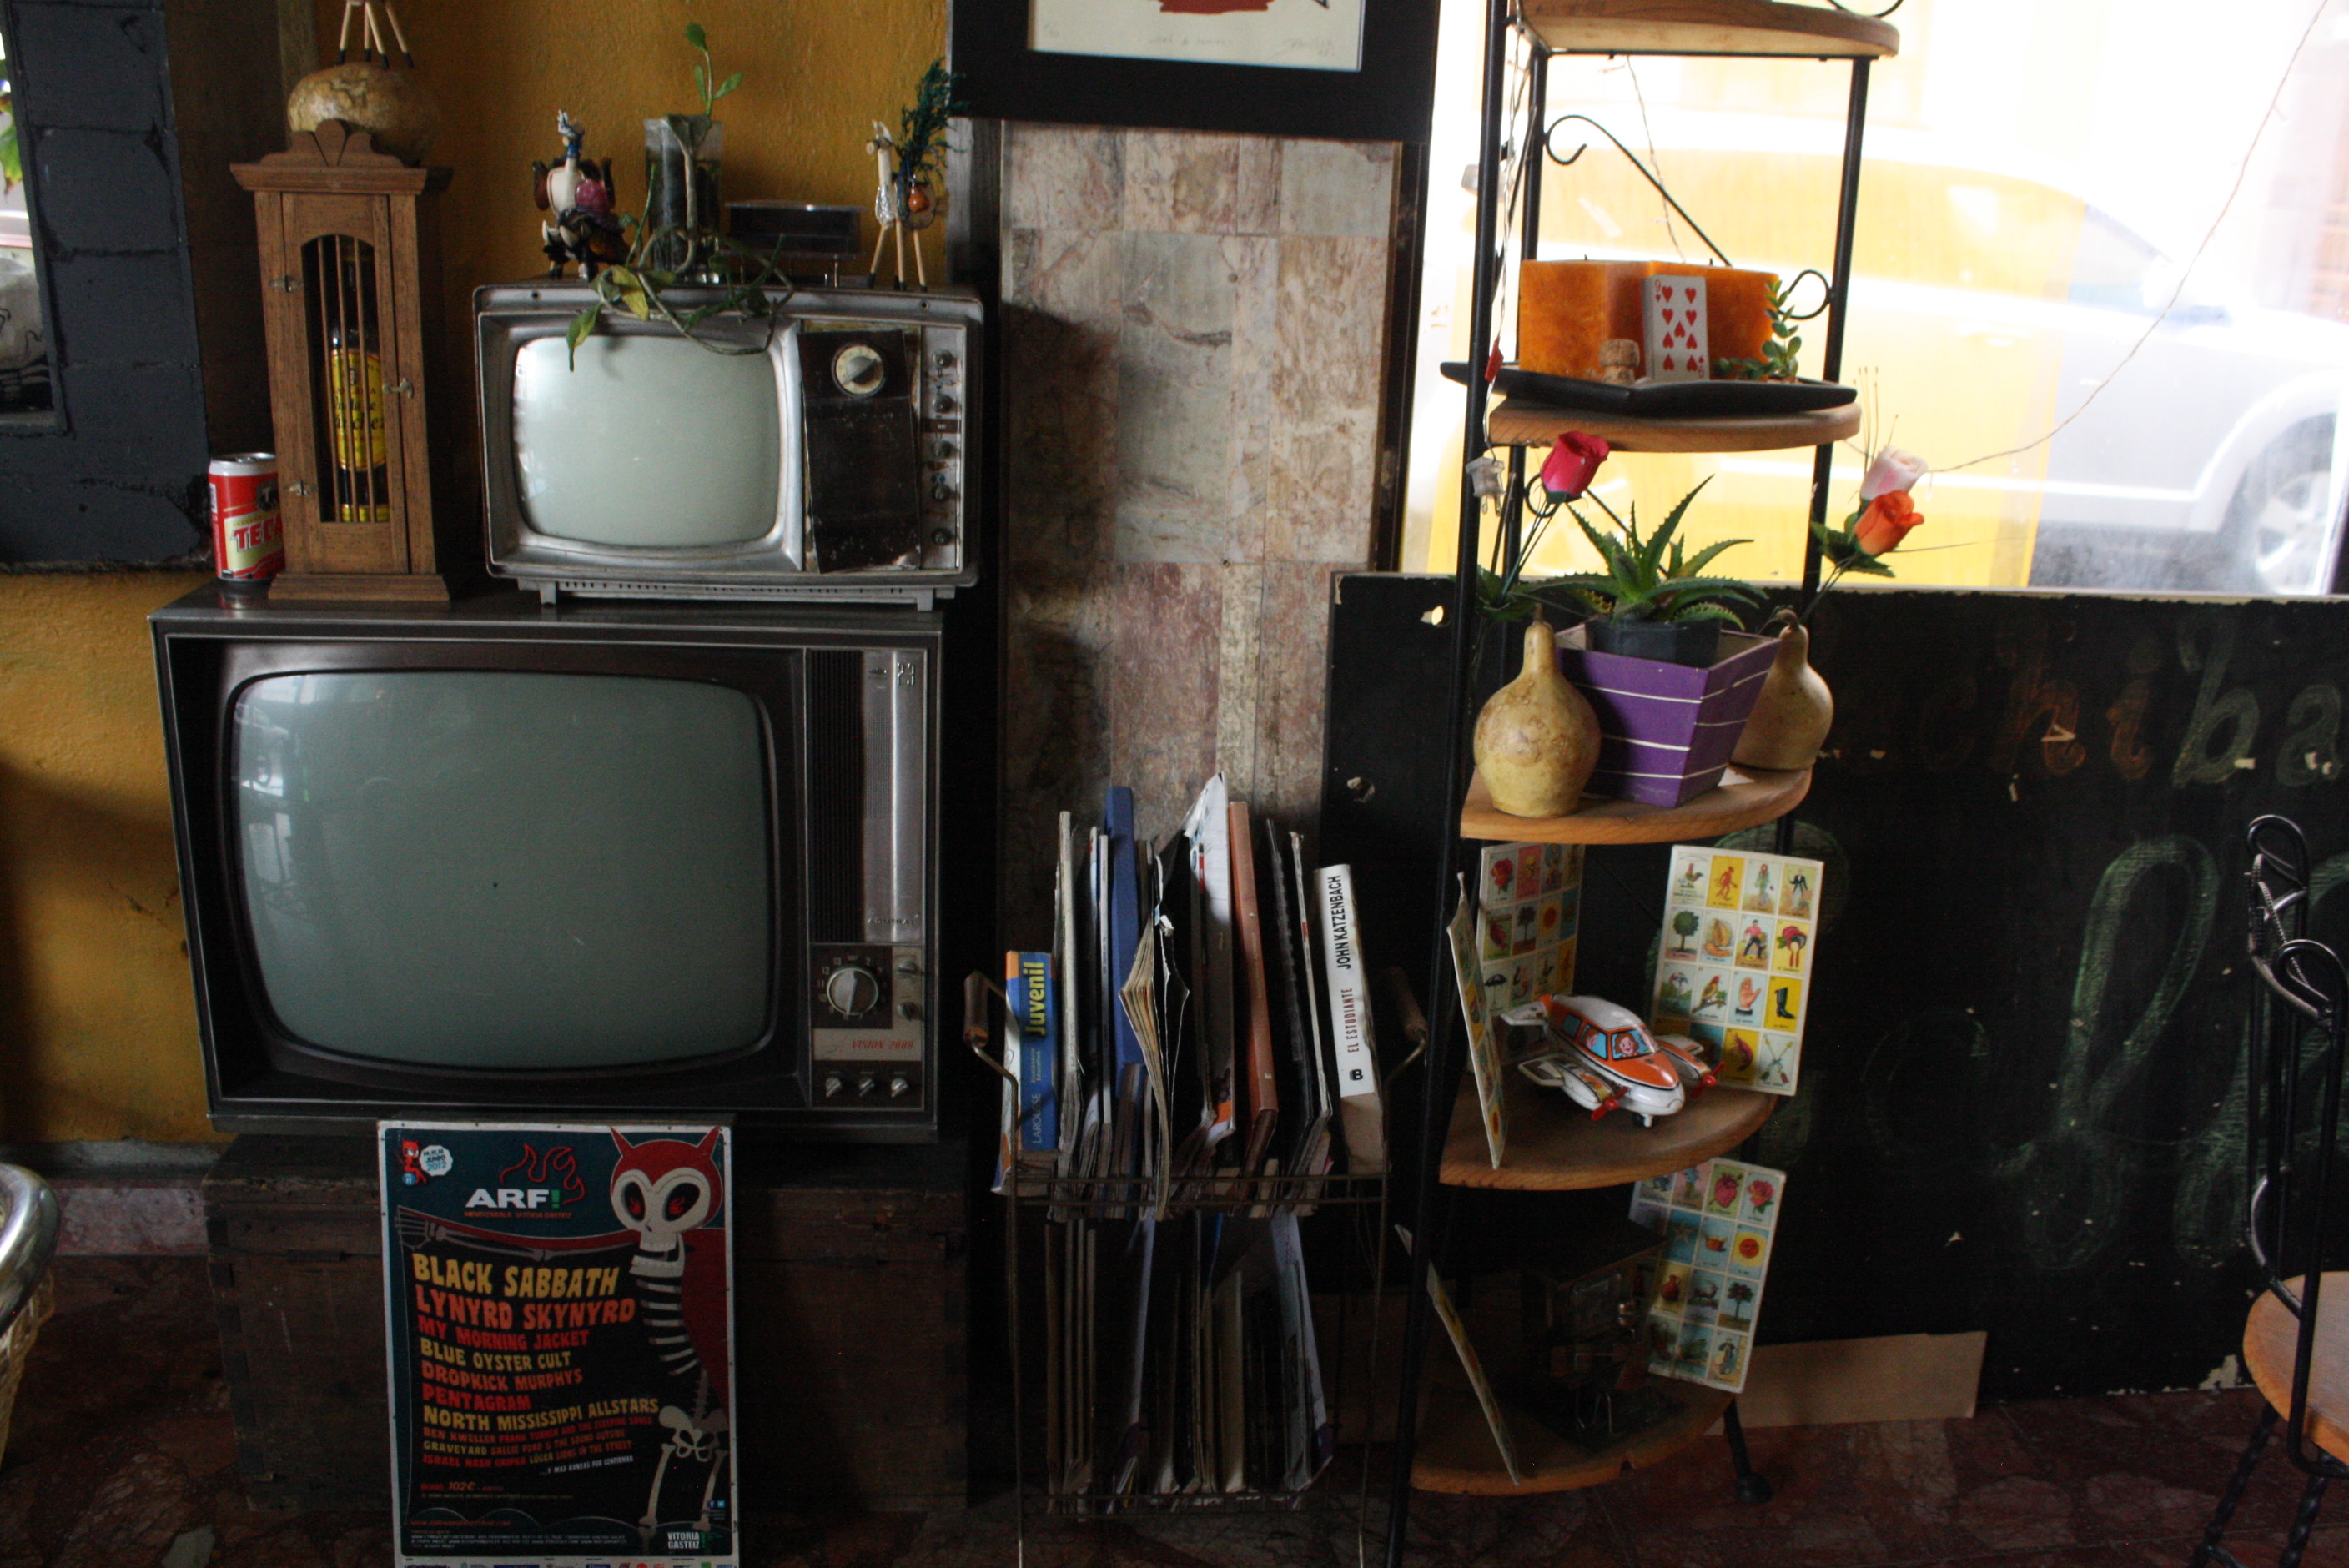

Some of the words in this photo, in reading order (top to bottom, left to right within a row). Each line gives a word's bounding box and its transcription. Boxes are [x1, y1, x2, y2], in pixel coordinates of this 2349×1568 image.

[1654, 279, 1662, 293] 9
[1327, 875, 1349, 943] KATZENBACH
[1336, 942, 1351, 970] JOHN
[1024, 962, 1045, 1037] Juvenil
[1340, 988, 1358, 1040] ESTUDIANTE
[852, 1040, 885, 1050] VISION
[1347, 1040, 1360, 1053] EL
[1349, 1069, 1363, 1082] B
[426, 1161, 447, 1172] 2012
[465, 1188, 561, 1209] ARF!
[412, 1253, 493, 1294] BLACK
[503, 1265, 621, 1298] SABBATH
[415, 1284, 514, 1329] LYNYRD
[522, 1297, 636, 1330] SKYNYRD
[417, 1314, 449, 1340] MY
[455, 1326, 528, 1351] MORNING
[534, 1329, 591, 1351] JACKET
[420, 1336, 467, 1366] BLUE
[473, 1351, 532, 1372] OYSTER
[537, 1350, 571, 1369] CULT
[421, 1359, 509, 1391] DROPKICK
[514, 1369, 584, 1391] MURPHYS
[421, 1382, 533, 1411] PENTAGRAM
[423, 1405, 490, 1431] NORTH
[496, 1405, 583, 1430] MISSISSIPPI
[588, 1398, 660, 1420] ALLSTARS
[423, 1426, 445, 1440] BEN
[450, 1431, 495, 1443] KWELLER
[498, 1433, 526, 1444] FRANK
[423, 1440, 487, 1455] GRAVEYARD
[423, 1454, 461, 1467] ISRAEL
[465, 1458, 492, 1468] NASH
[591, 1459, 602, 1467] POR
[667, 1531, 700, 1540] VITORIA
[667, 1540, 700, 1550] GASTEIZ
